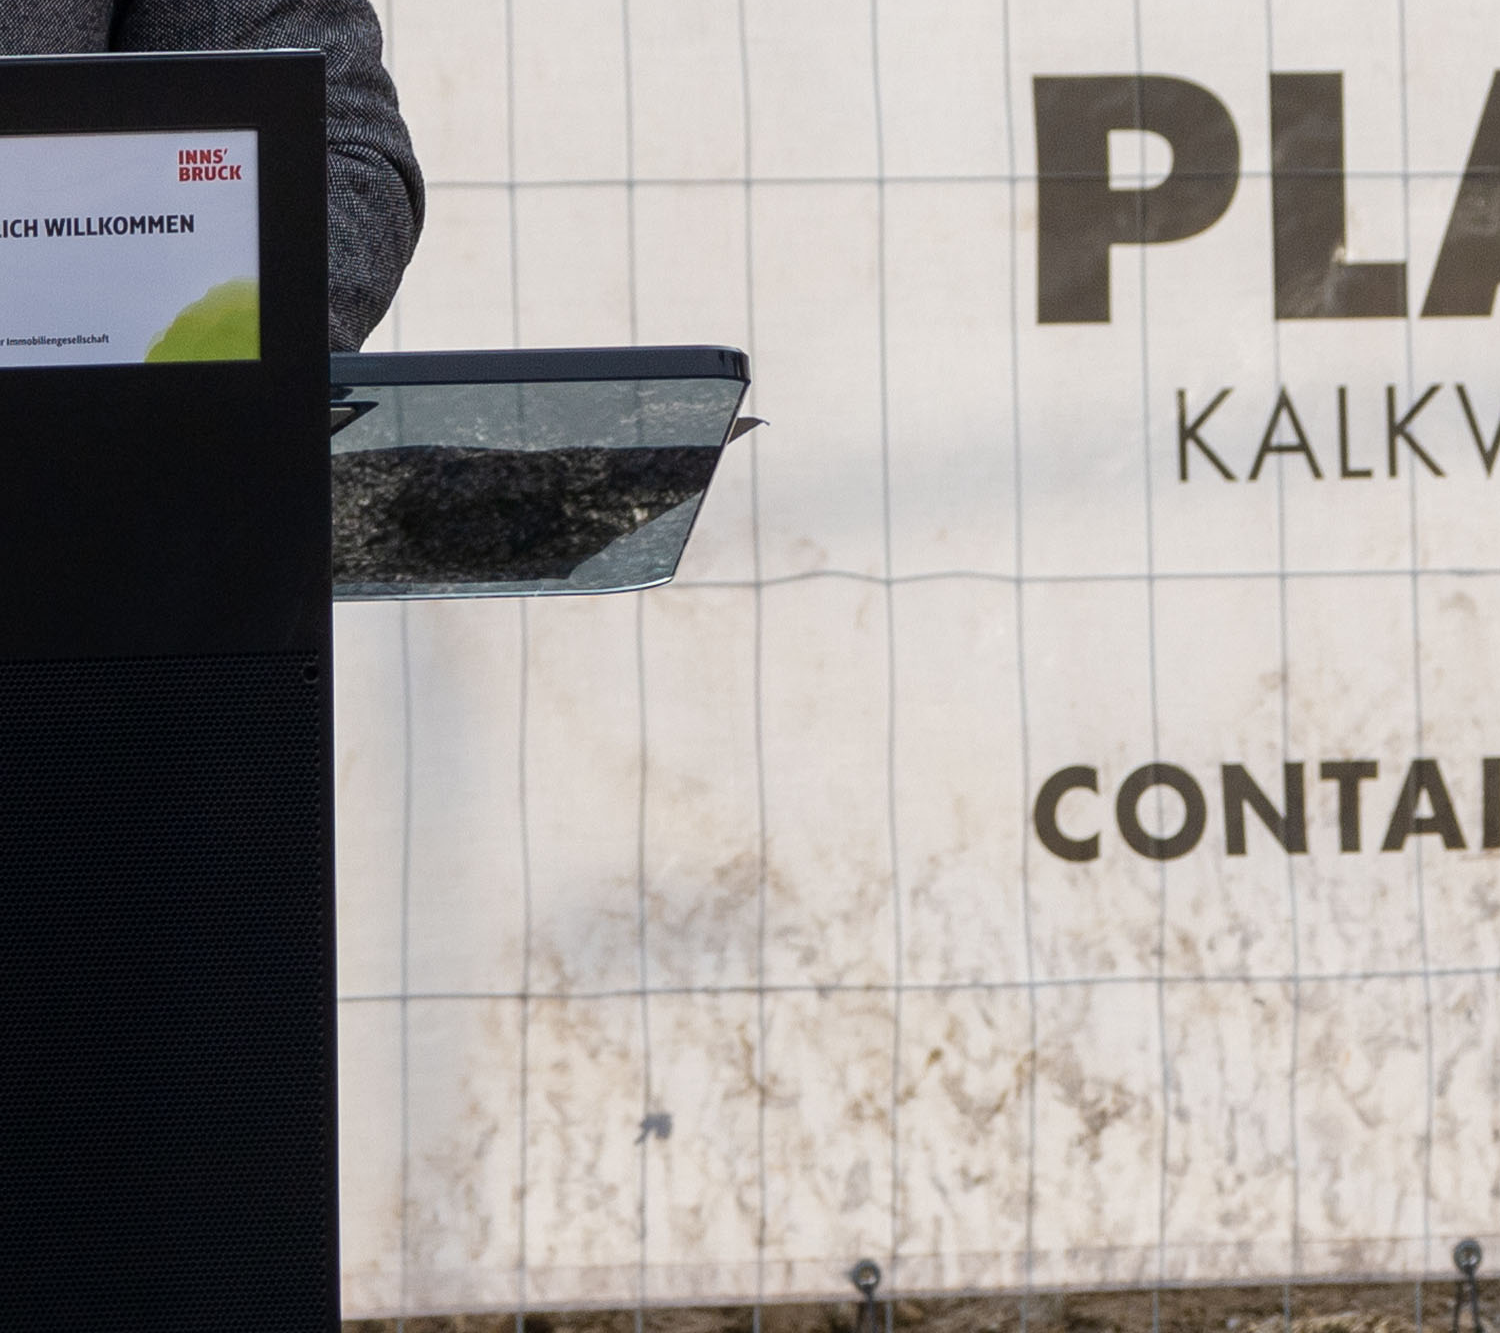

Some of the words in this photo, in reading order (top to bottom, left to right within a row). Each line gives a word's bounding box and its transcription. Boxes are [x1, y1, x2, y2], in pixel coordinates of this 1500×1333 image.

[178, 164, 242, 182] BRUCK
[44, 214, 195, 238] WILLKOMMEN
[6, 333, 110, 348] Immobiliengesellschaft
